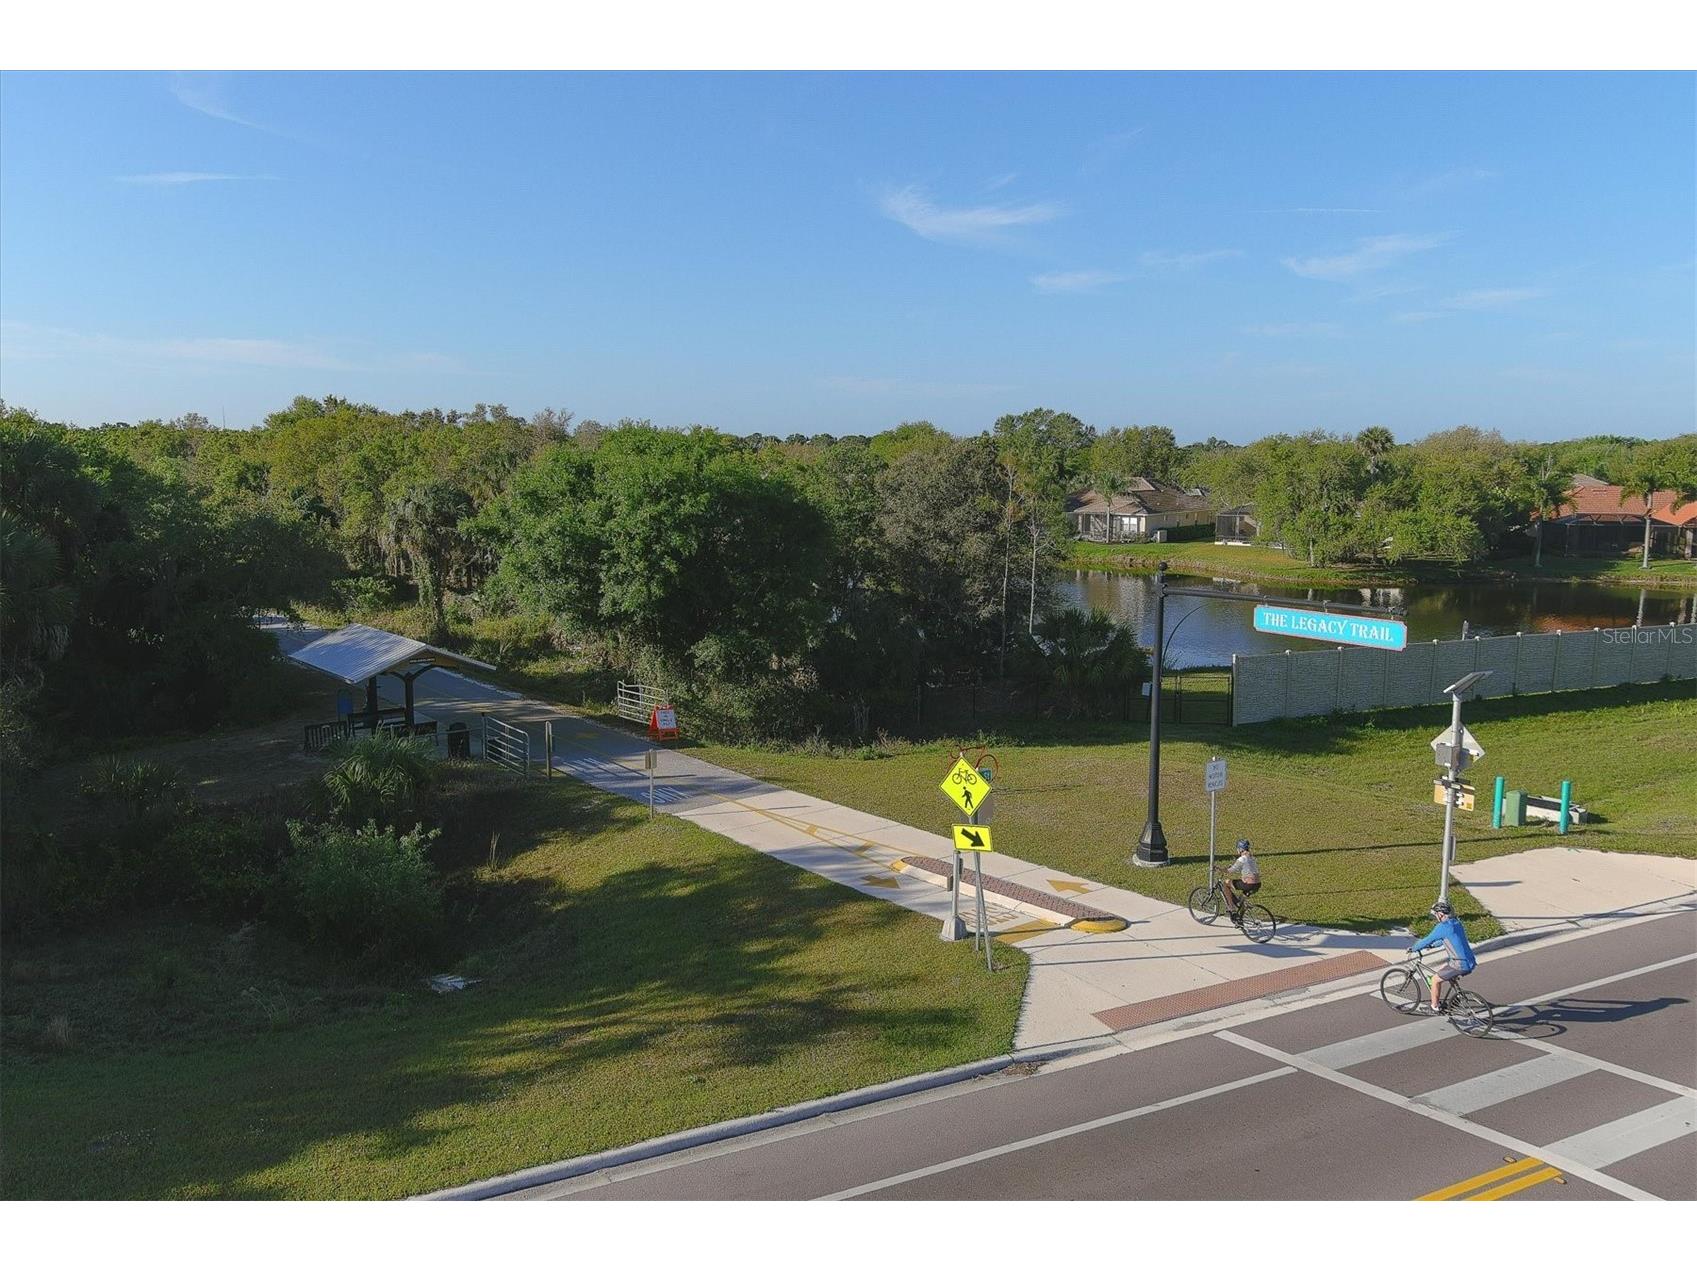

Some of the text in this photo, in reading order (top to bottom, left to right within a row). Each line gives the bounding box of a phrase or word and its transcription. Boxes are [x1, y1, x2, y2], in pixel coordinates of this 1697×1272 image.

[1263, 612, 1394, 642] THE LEGACY TRAIL
